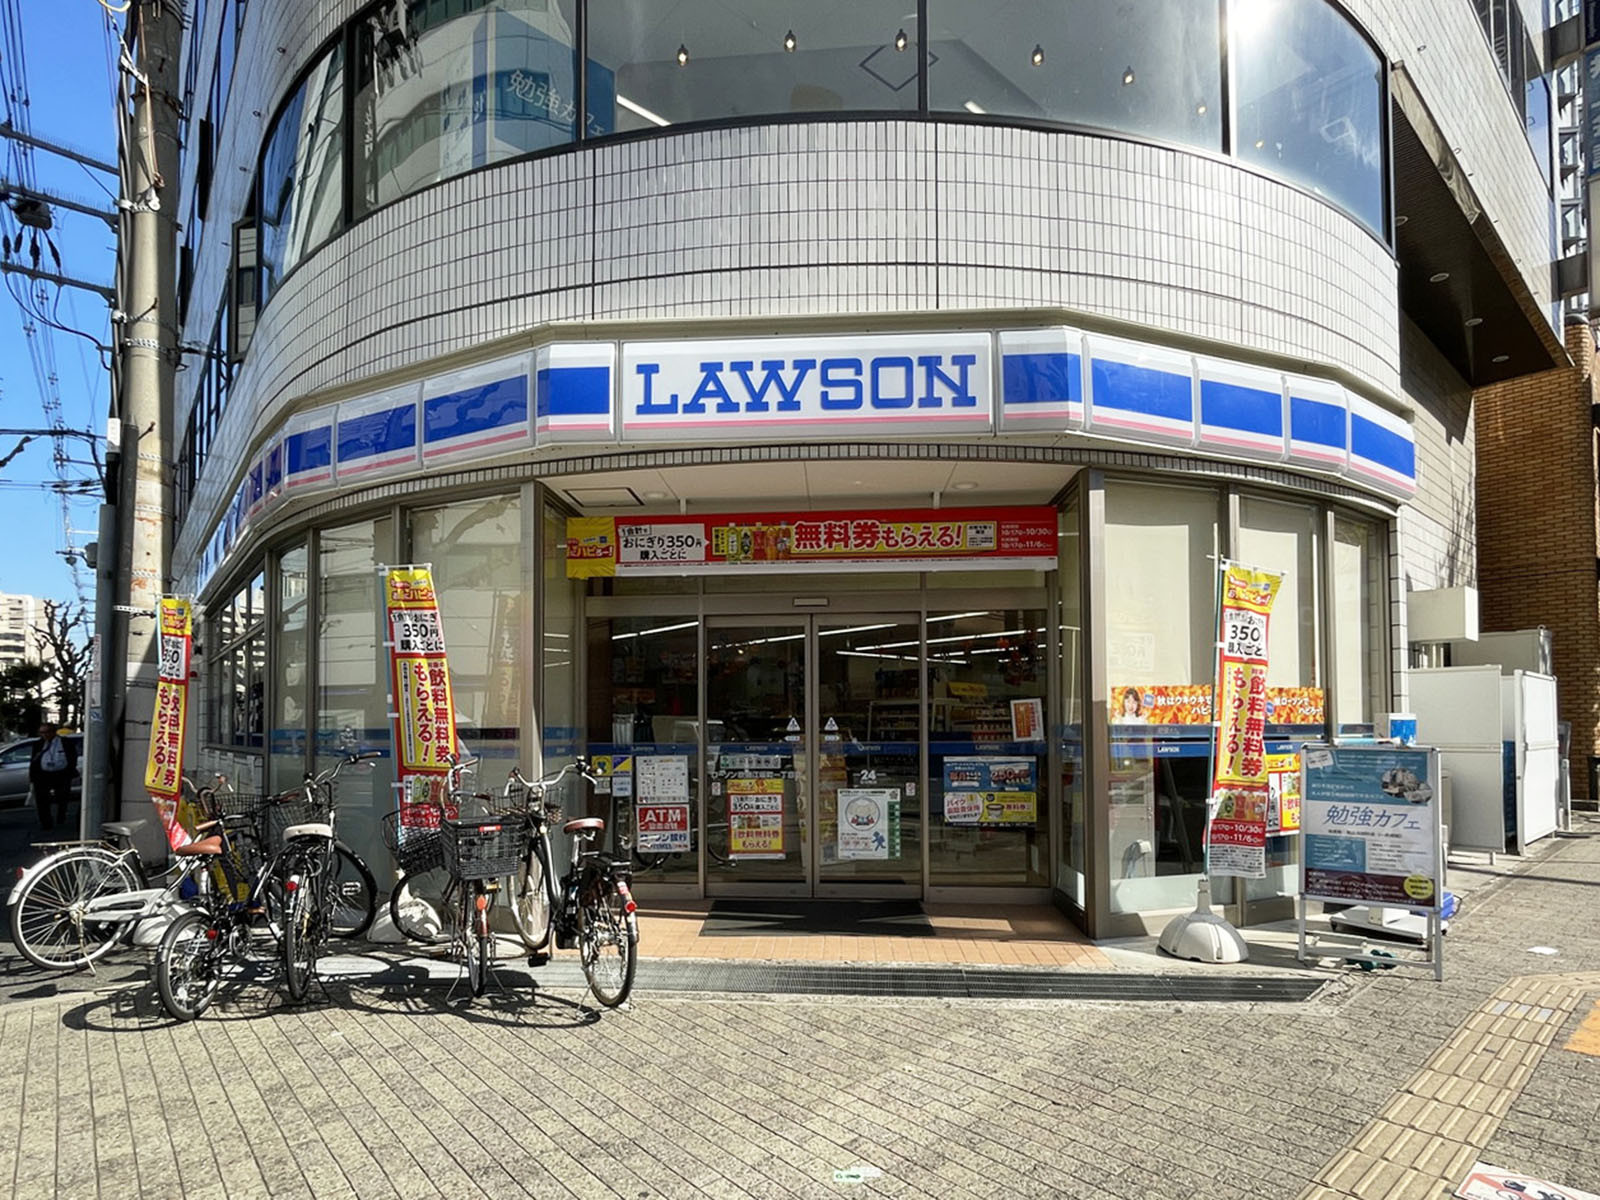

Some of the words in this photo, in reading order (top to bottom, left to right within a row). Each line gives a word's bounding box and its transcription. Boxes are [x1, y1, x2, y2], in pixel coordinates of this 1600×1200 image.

[636, 354, 976, 415] LAWSON
[623, 535, 702, 549] おにぎり350円
[640, 548, 687, 560] 購入ごとに
[1241, 675, 1265, 777] 飲料無料券
[860, 769, 877, 780] 24
[645, 809, 680, 822] ATM
[1323, 805, 1421, 830] 勉強カフェ
